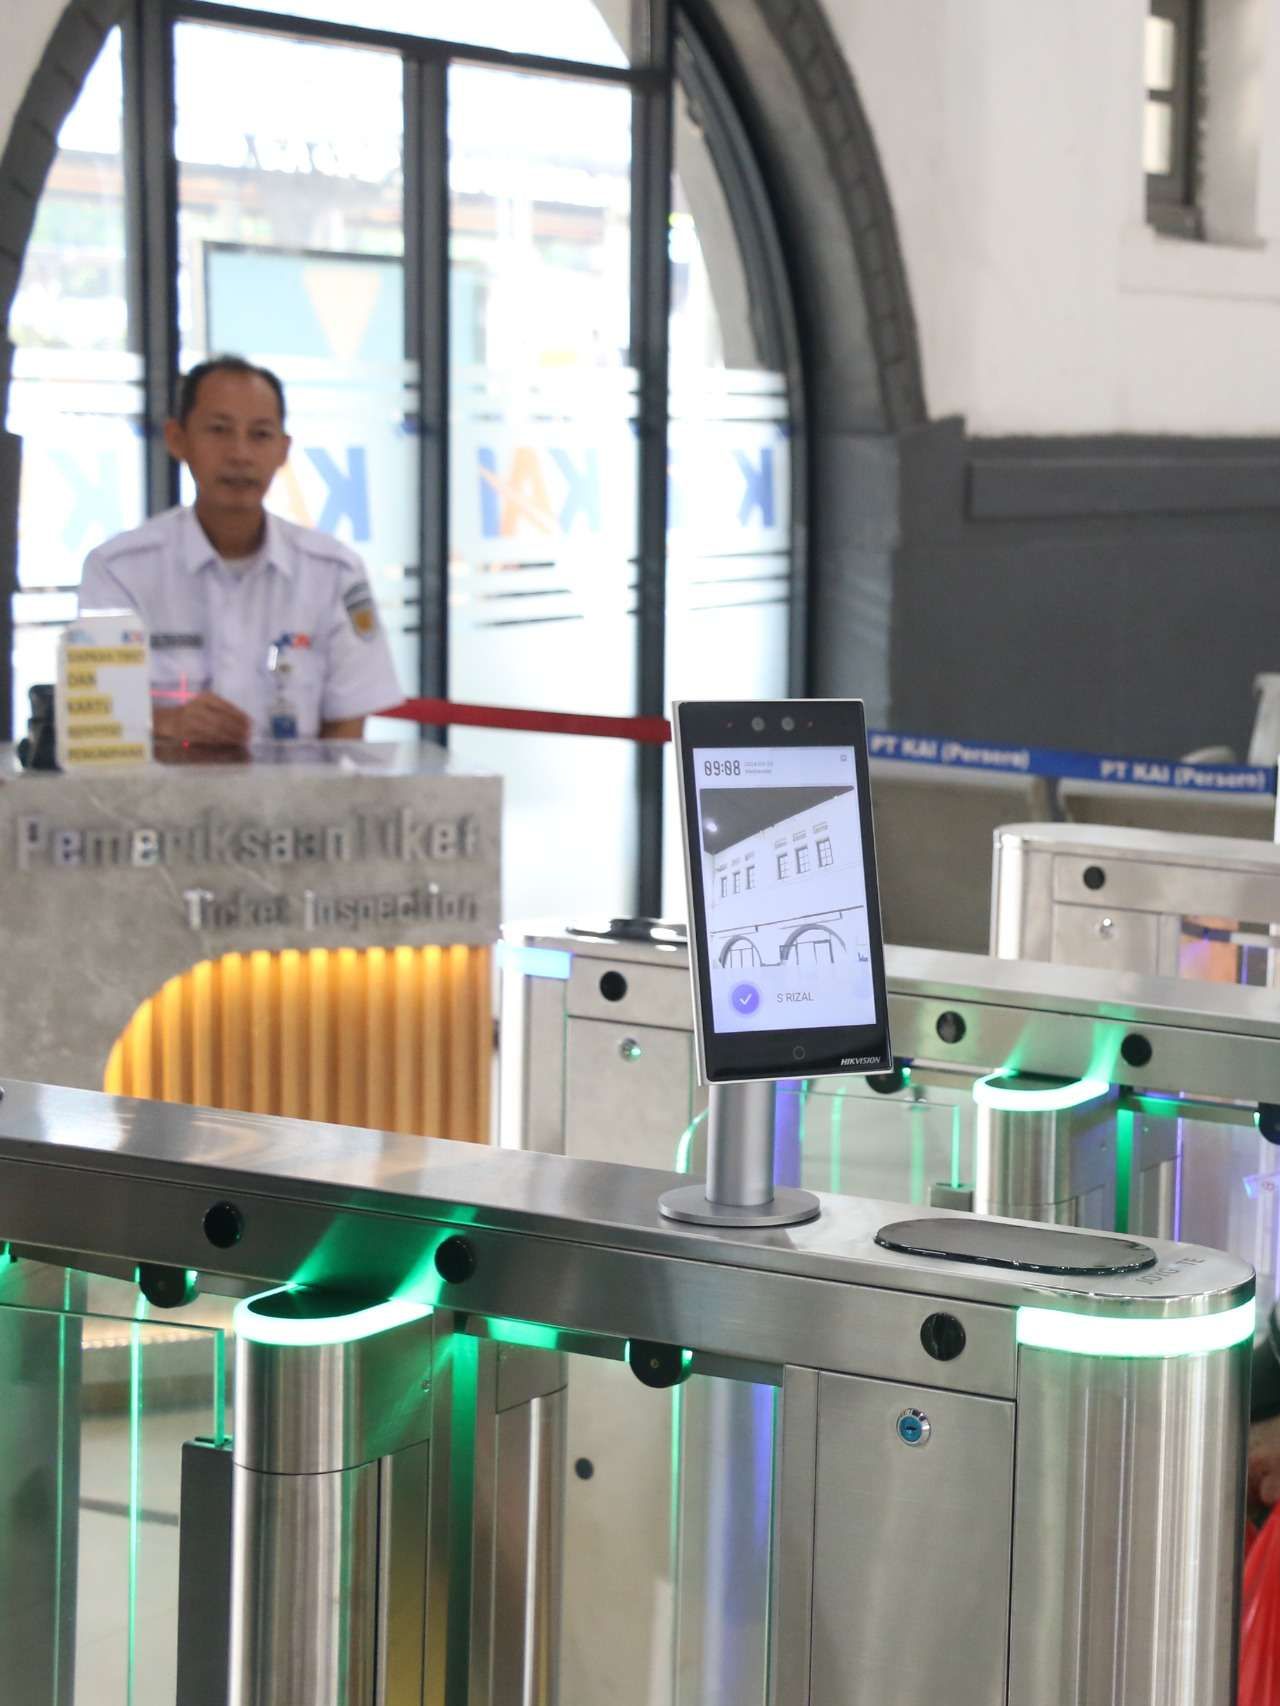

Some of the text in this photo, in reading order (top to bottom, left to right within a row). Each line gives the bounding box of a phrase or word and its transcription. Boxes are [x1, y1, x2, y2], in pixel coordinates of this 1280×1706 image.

[870, 735, 896, 752] PT
[903, 738, 937, 758] KAI
[704, 760, 741, 776] 09:08
[1101, 760, 1127, 779] PT
[1133, 763, 1170, 784] KAI
[17, 810, 352, 870] Pemeriksaan
[777, 992, 814, 1003] S RIZAL
[841, 1057, 880, 1066] HIKVISION
